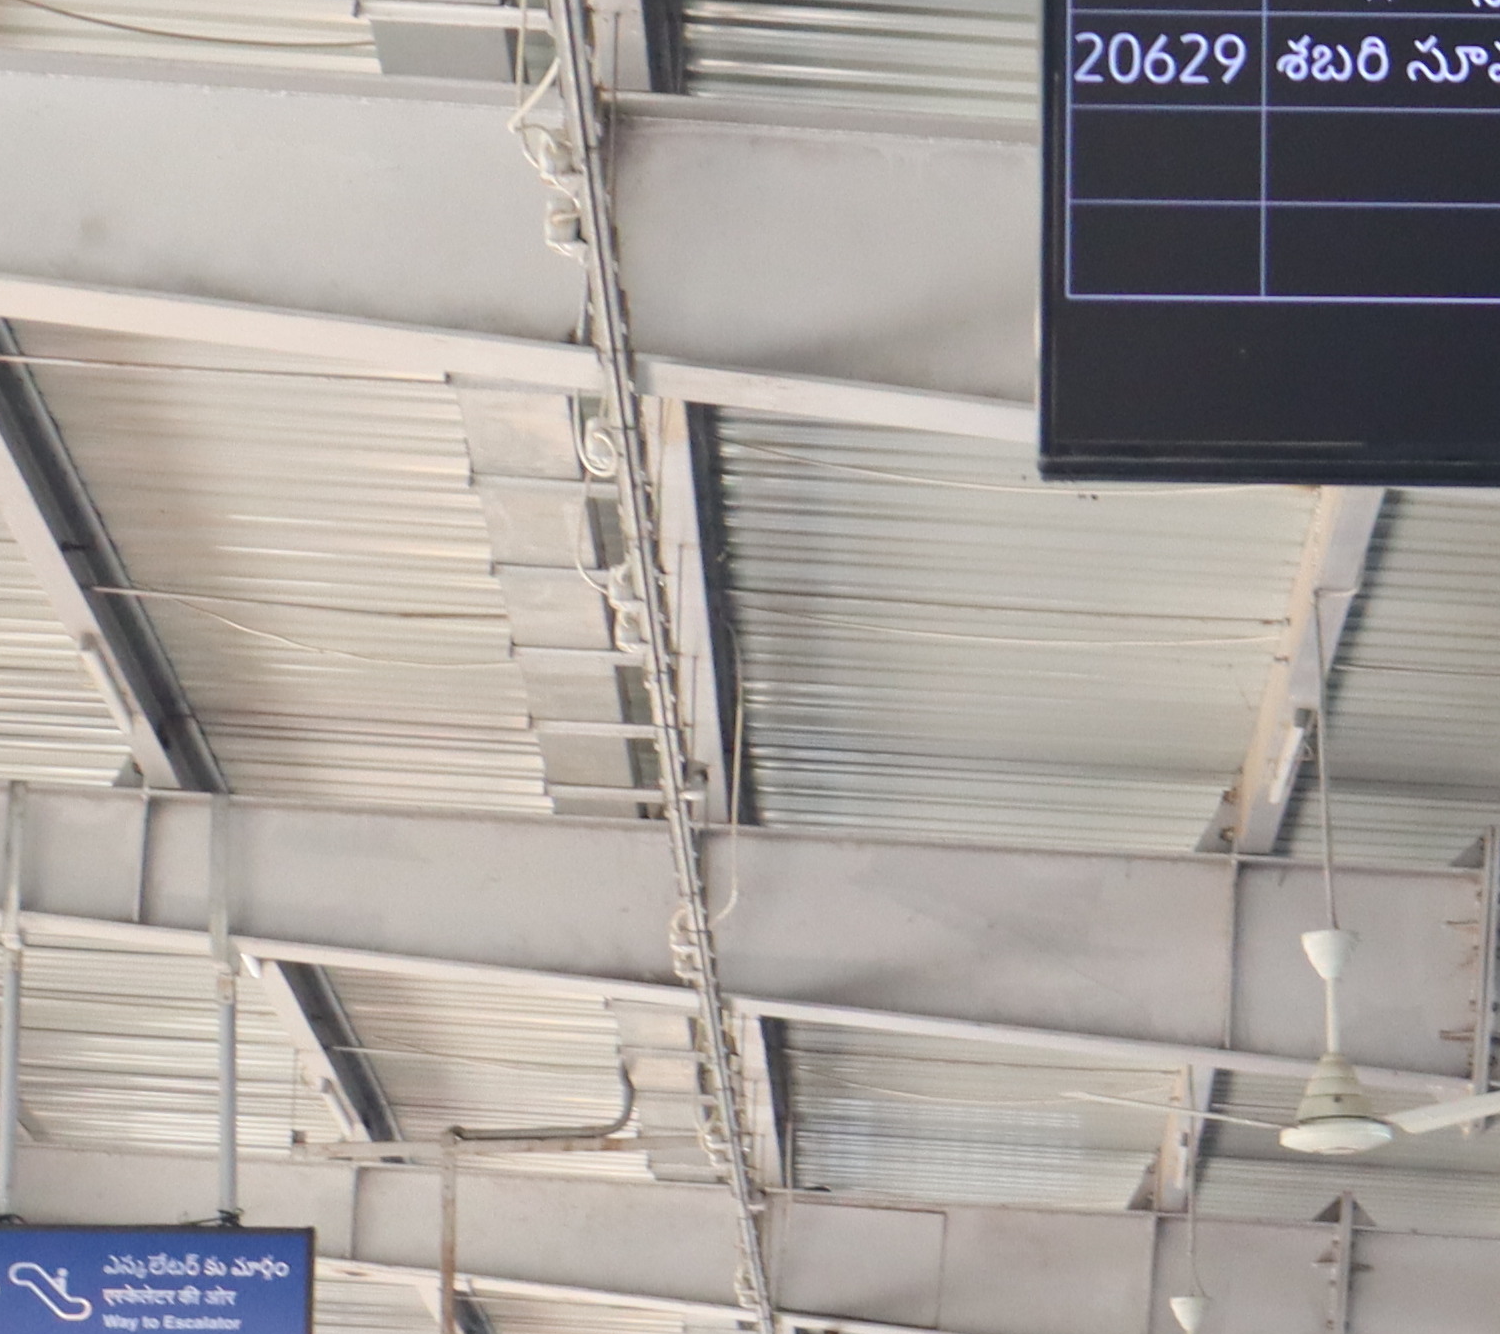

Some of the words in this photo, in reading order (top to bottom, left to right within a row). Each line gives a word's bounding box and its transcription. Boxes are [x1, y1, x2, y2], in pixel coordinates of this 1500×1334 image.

[1074, 32, 1246, 83] 20629
[1277, 35, 1389, 81] శబరి
[163, 1315, 242, 1330] Escalator
